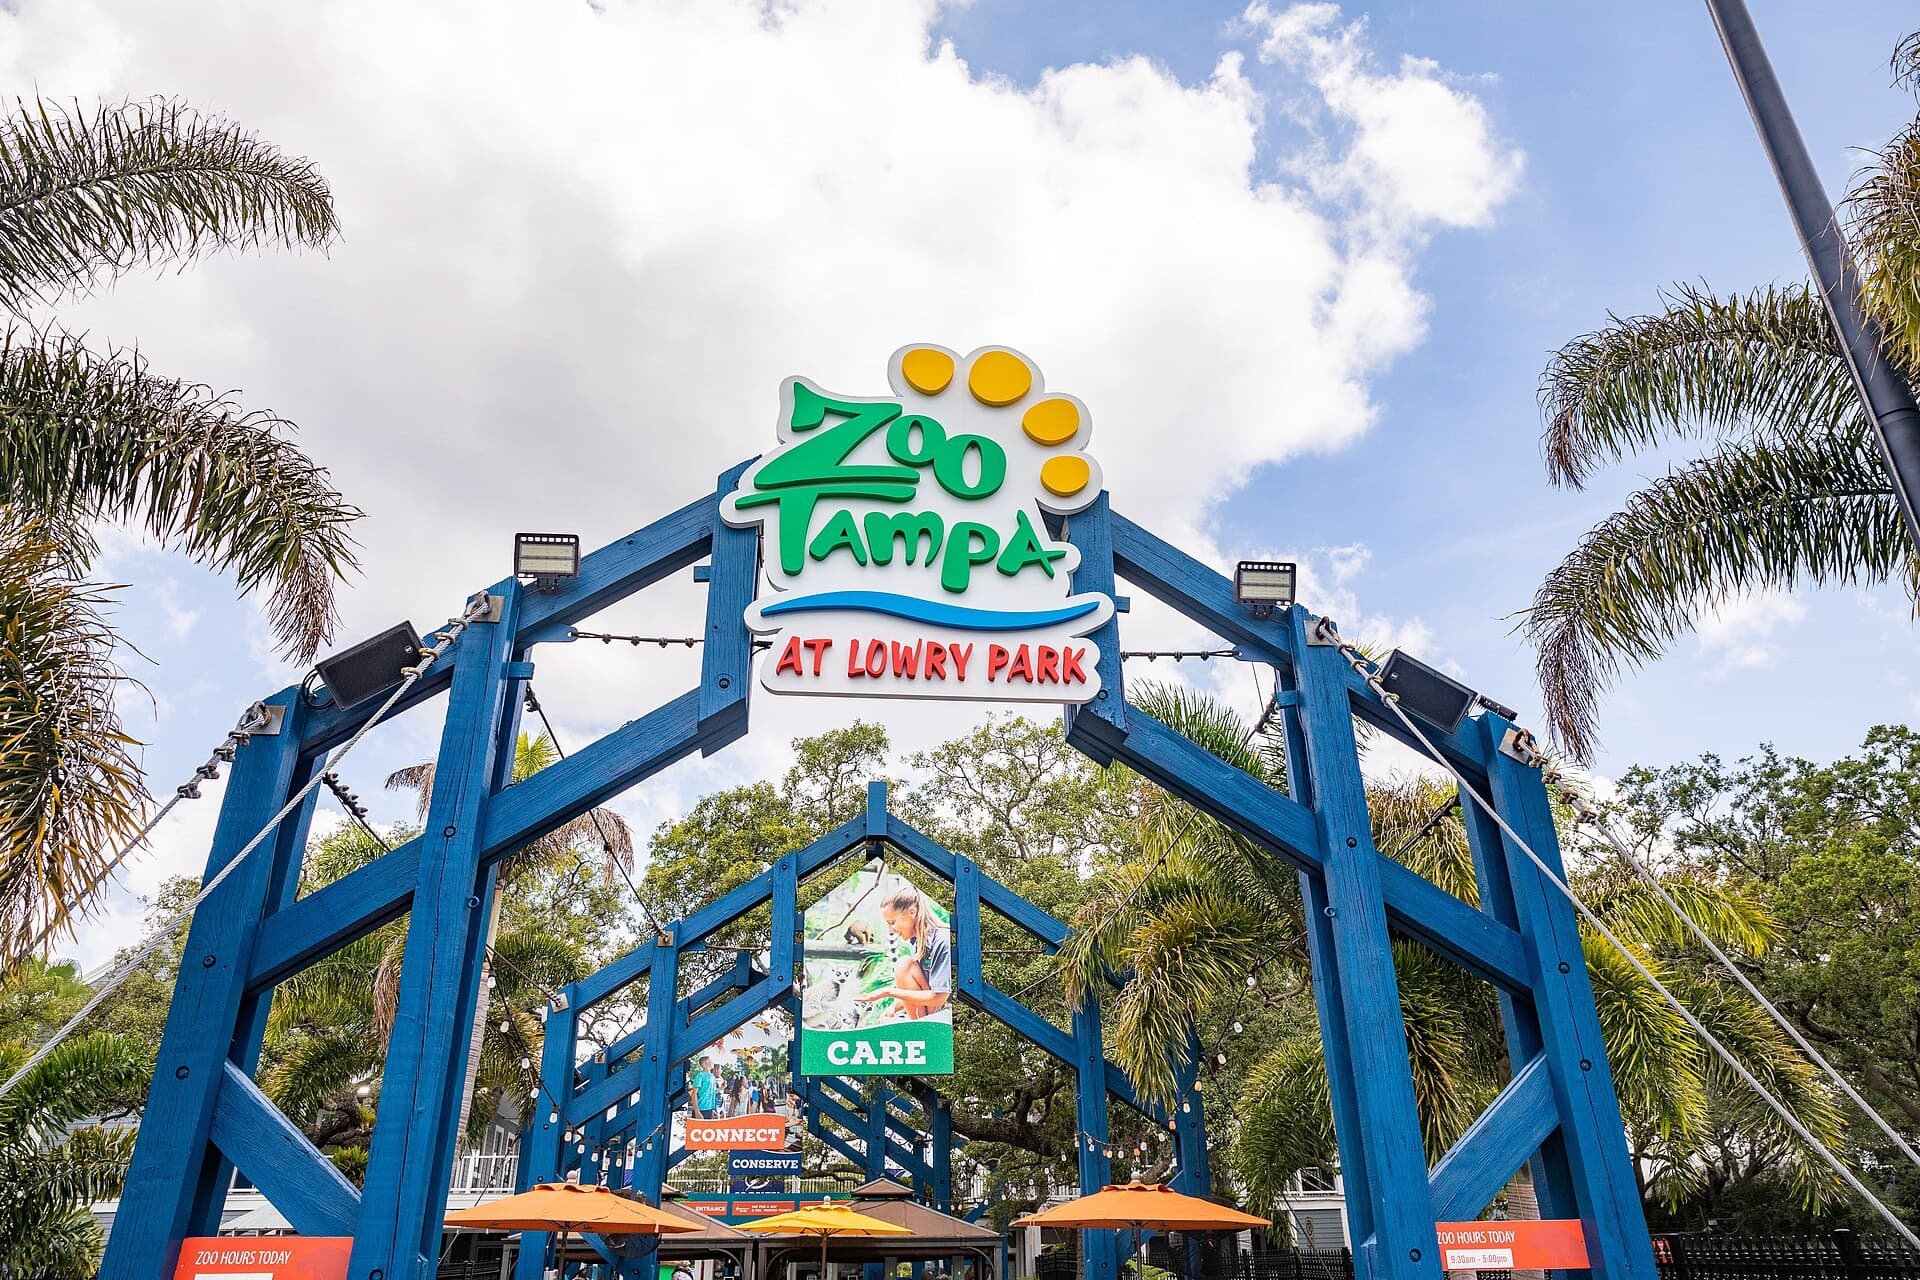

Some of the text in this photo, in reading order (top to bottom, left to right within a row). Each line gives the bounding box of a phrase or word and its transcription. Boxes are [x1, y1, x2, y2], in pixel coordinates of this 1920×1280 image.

[776, 636, 1087, 684] AT LOWRY PARK
[827, 1040, 927, 1066] CARE
[690, 1128, 780, 1143] CONNECT
[732, 1158, 799, 1170] CONSERVE
[1437, 1230, 1516, 1245] ZOO HOURS TODAY
[195, 1250, 292, 1265] ZOO HOURS TODAY
[1450, 1255, 1476, 1264] 9:30am
[1482, 1254, 1508, 1265] 5:00pm
